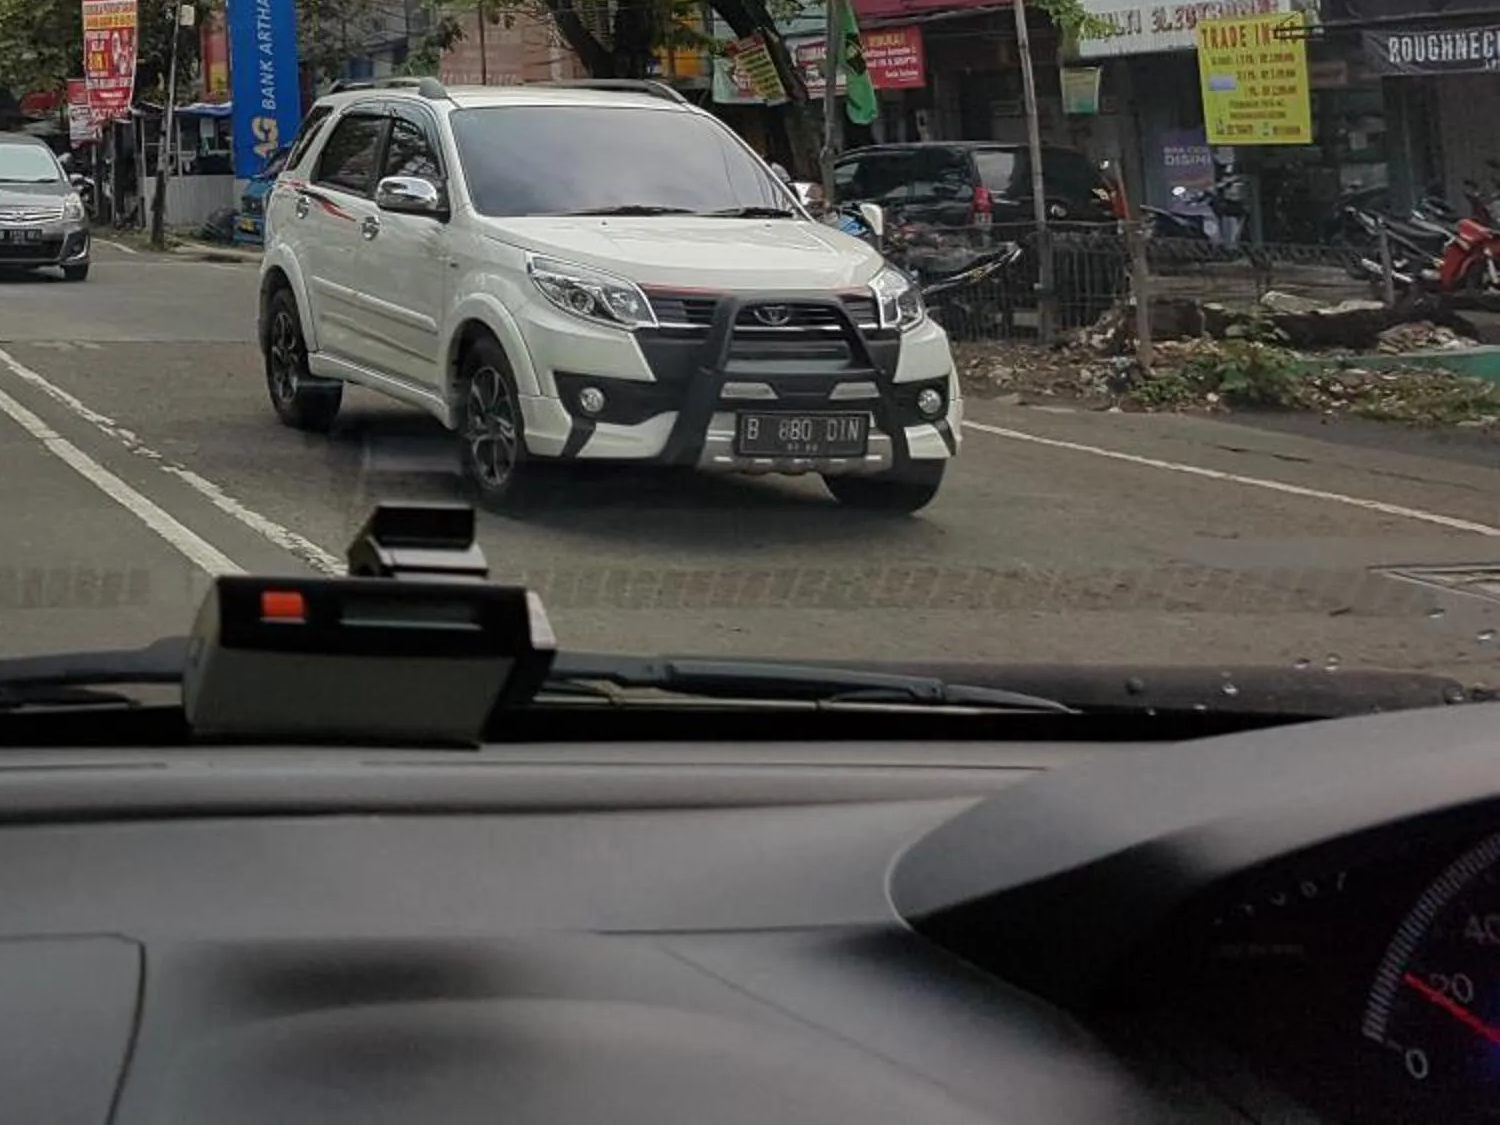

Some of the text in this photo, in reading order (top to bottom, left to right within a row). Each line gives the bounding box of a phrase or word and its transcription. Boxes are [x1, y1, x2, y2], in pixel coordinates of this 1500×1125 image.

[1201, 25, 1248, 50] TRADE
[259, 60, 277, 110] BANK
[747, 418, 759, 440] B
[1404, 1047, 1430, 1080] 0
